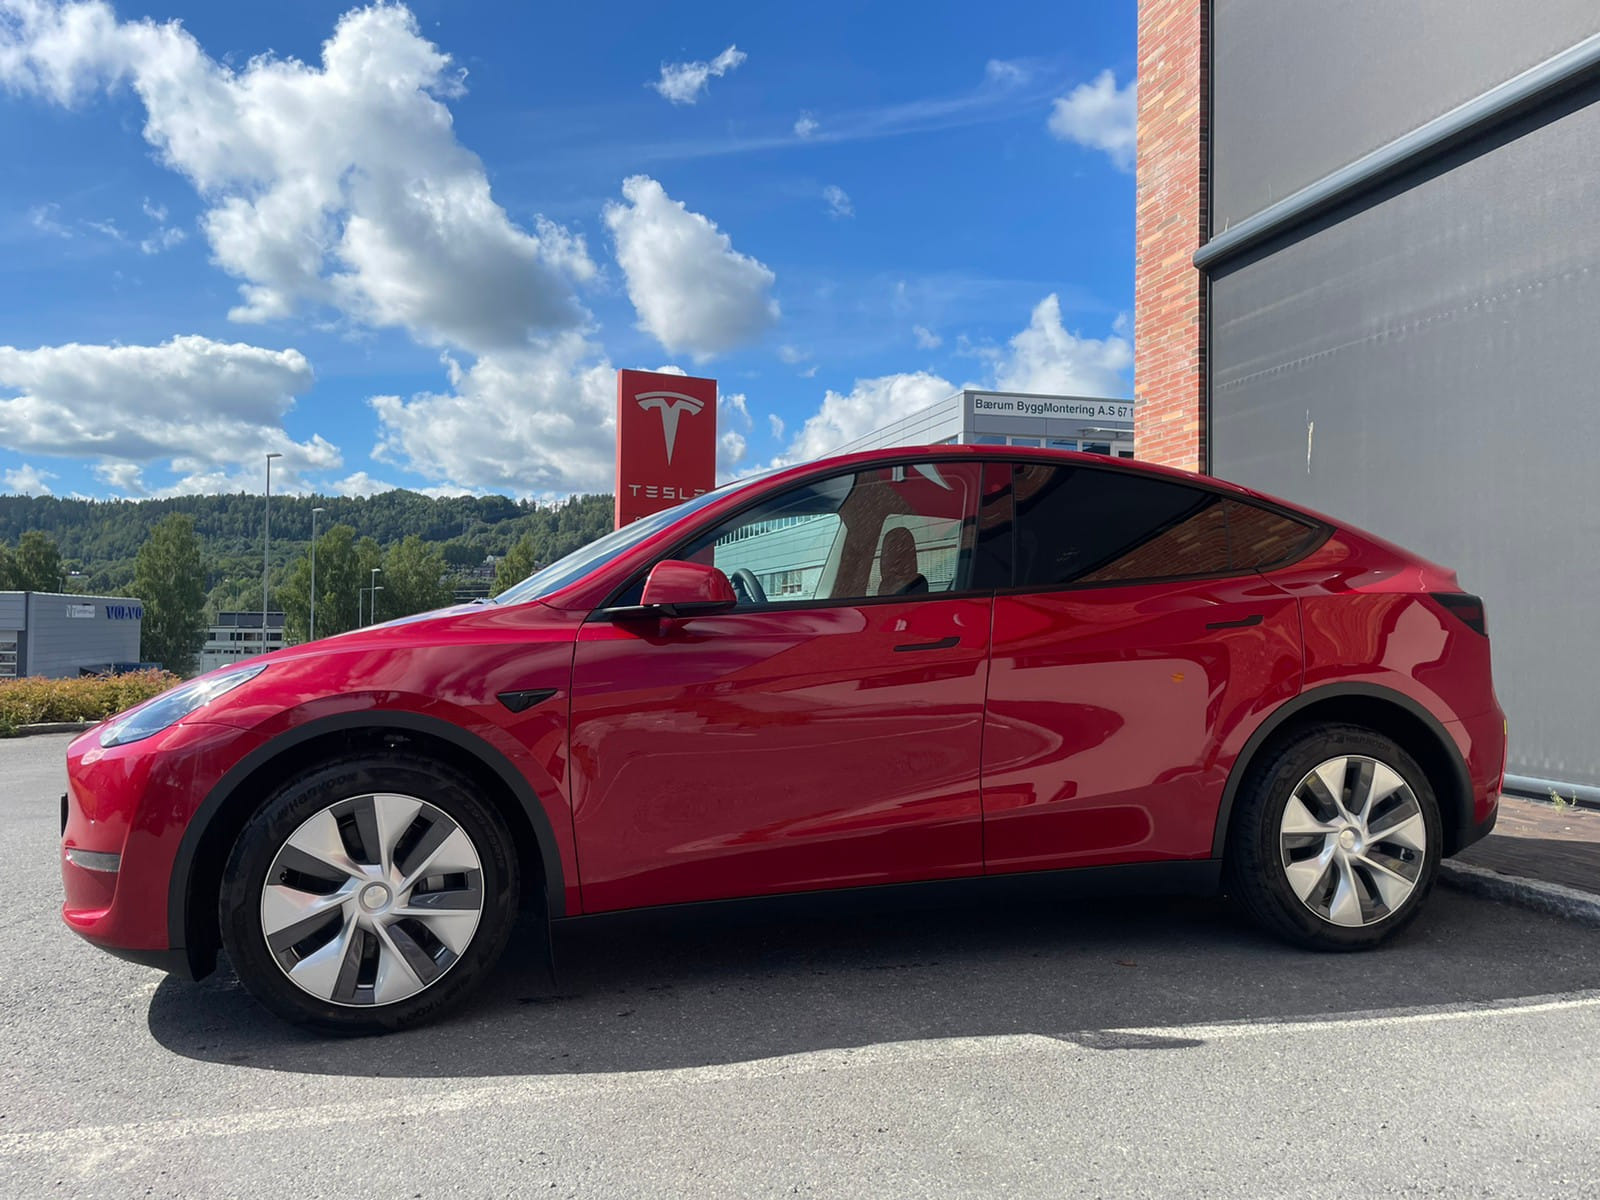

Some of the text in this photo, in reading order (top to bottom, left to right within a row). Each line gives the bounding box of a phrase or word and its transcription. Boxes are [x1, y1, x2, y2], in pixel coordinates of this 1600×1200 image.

[975, 399, 1014, 410] Bærum
[1017, 401, 1095, 416] ByggMontering
[1098, 406, 1115, 416] A.S
[1118, 407, 1128, 417] 67
